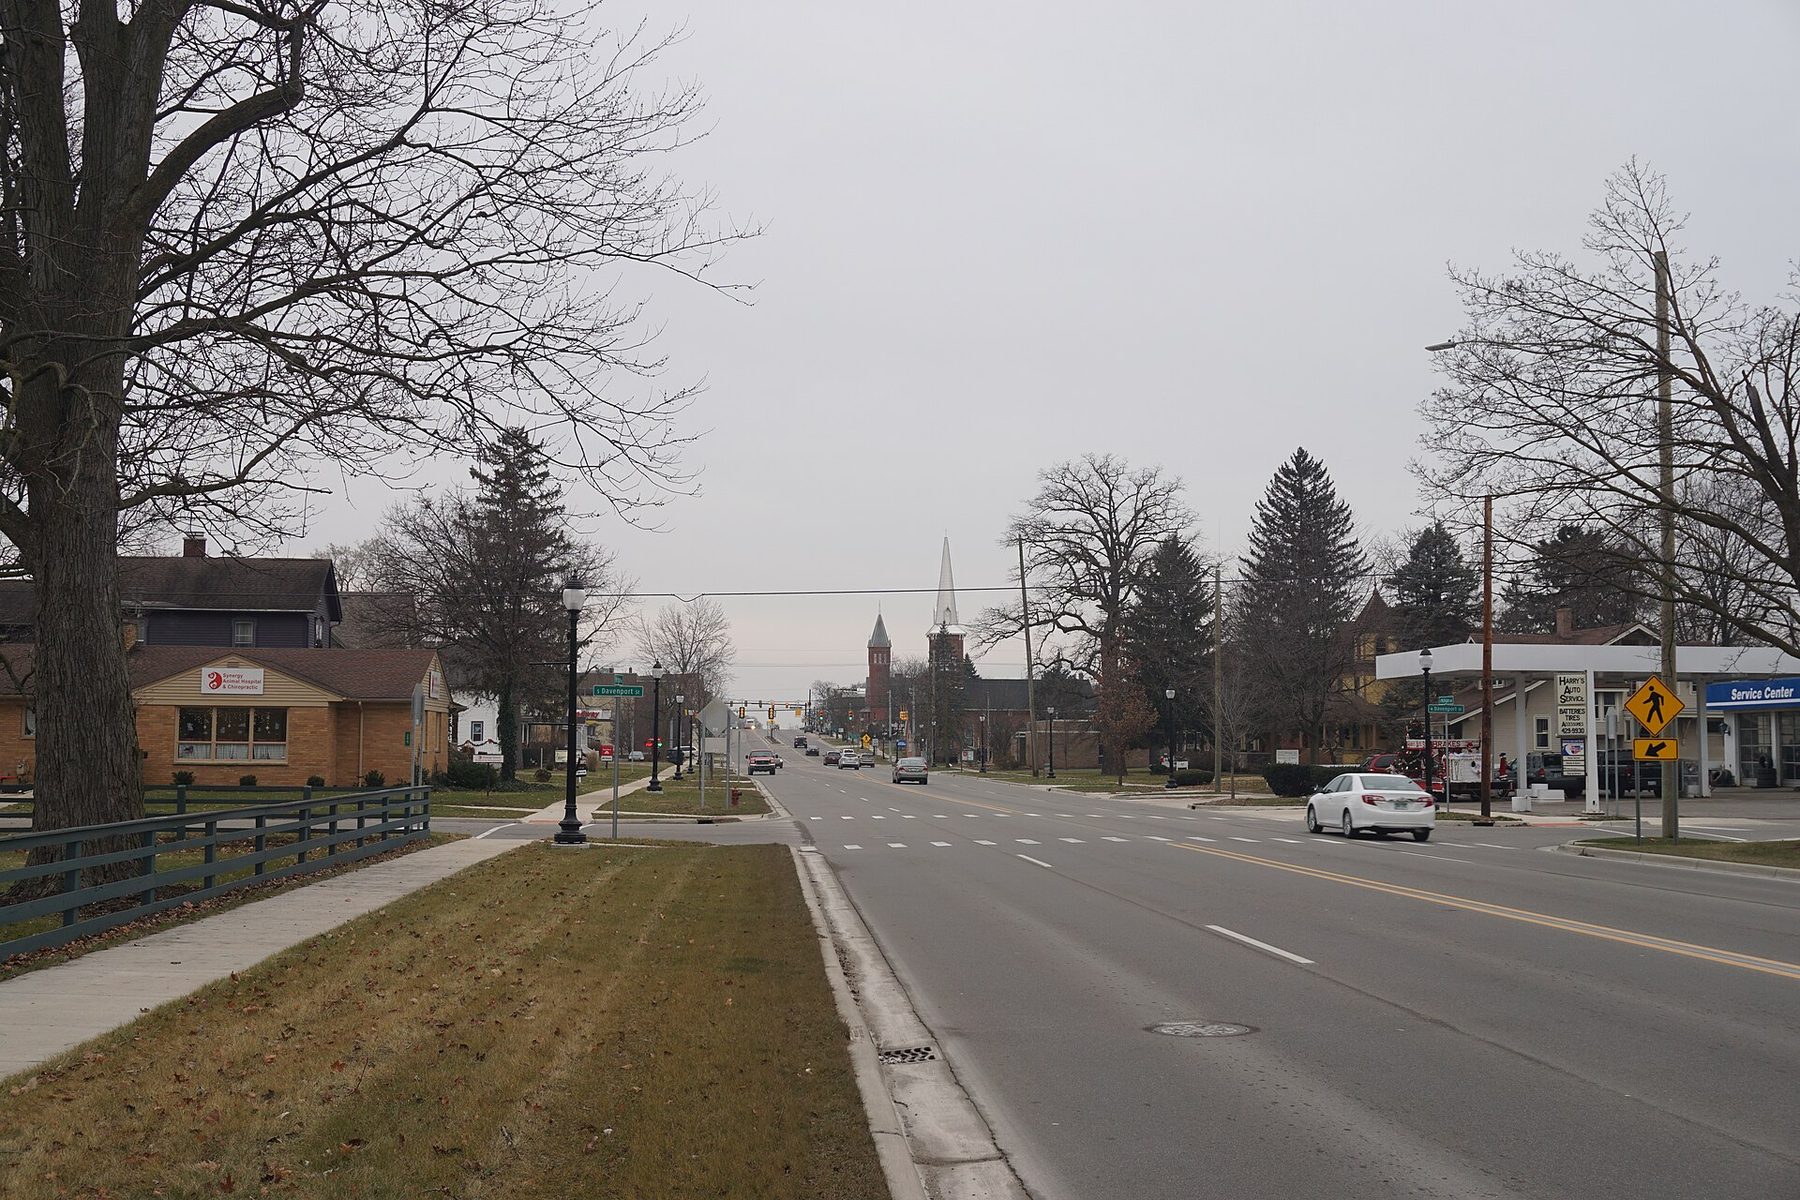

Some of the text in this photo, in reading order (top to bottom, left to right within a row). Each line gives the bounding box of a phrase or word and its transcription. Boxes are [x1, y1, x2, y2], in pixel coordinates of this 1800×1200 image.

[1559, 676, 1584, 685] HARRY'S
[1564, 686, 1580, 694] AUTO
[1731, 686, 1794, 700] Service Center
[1560, 694, 1584, 704] SERVICE
